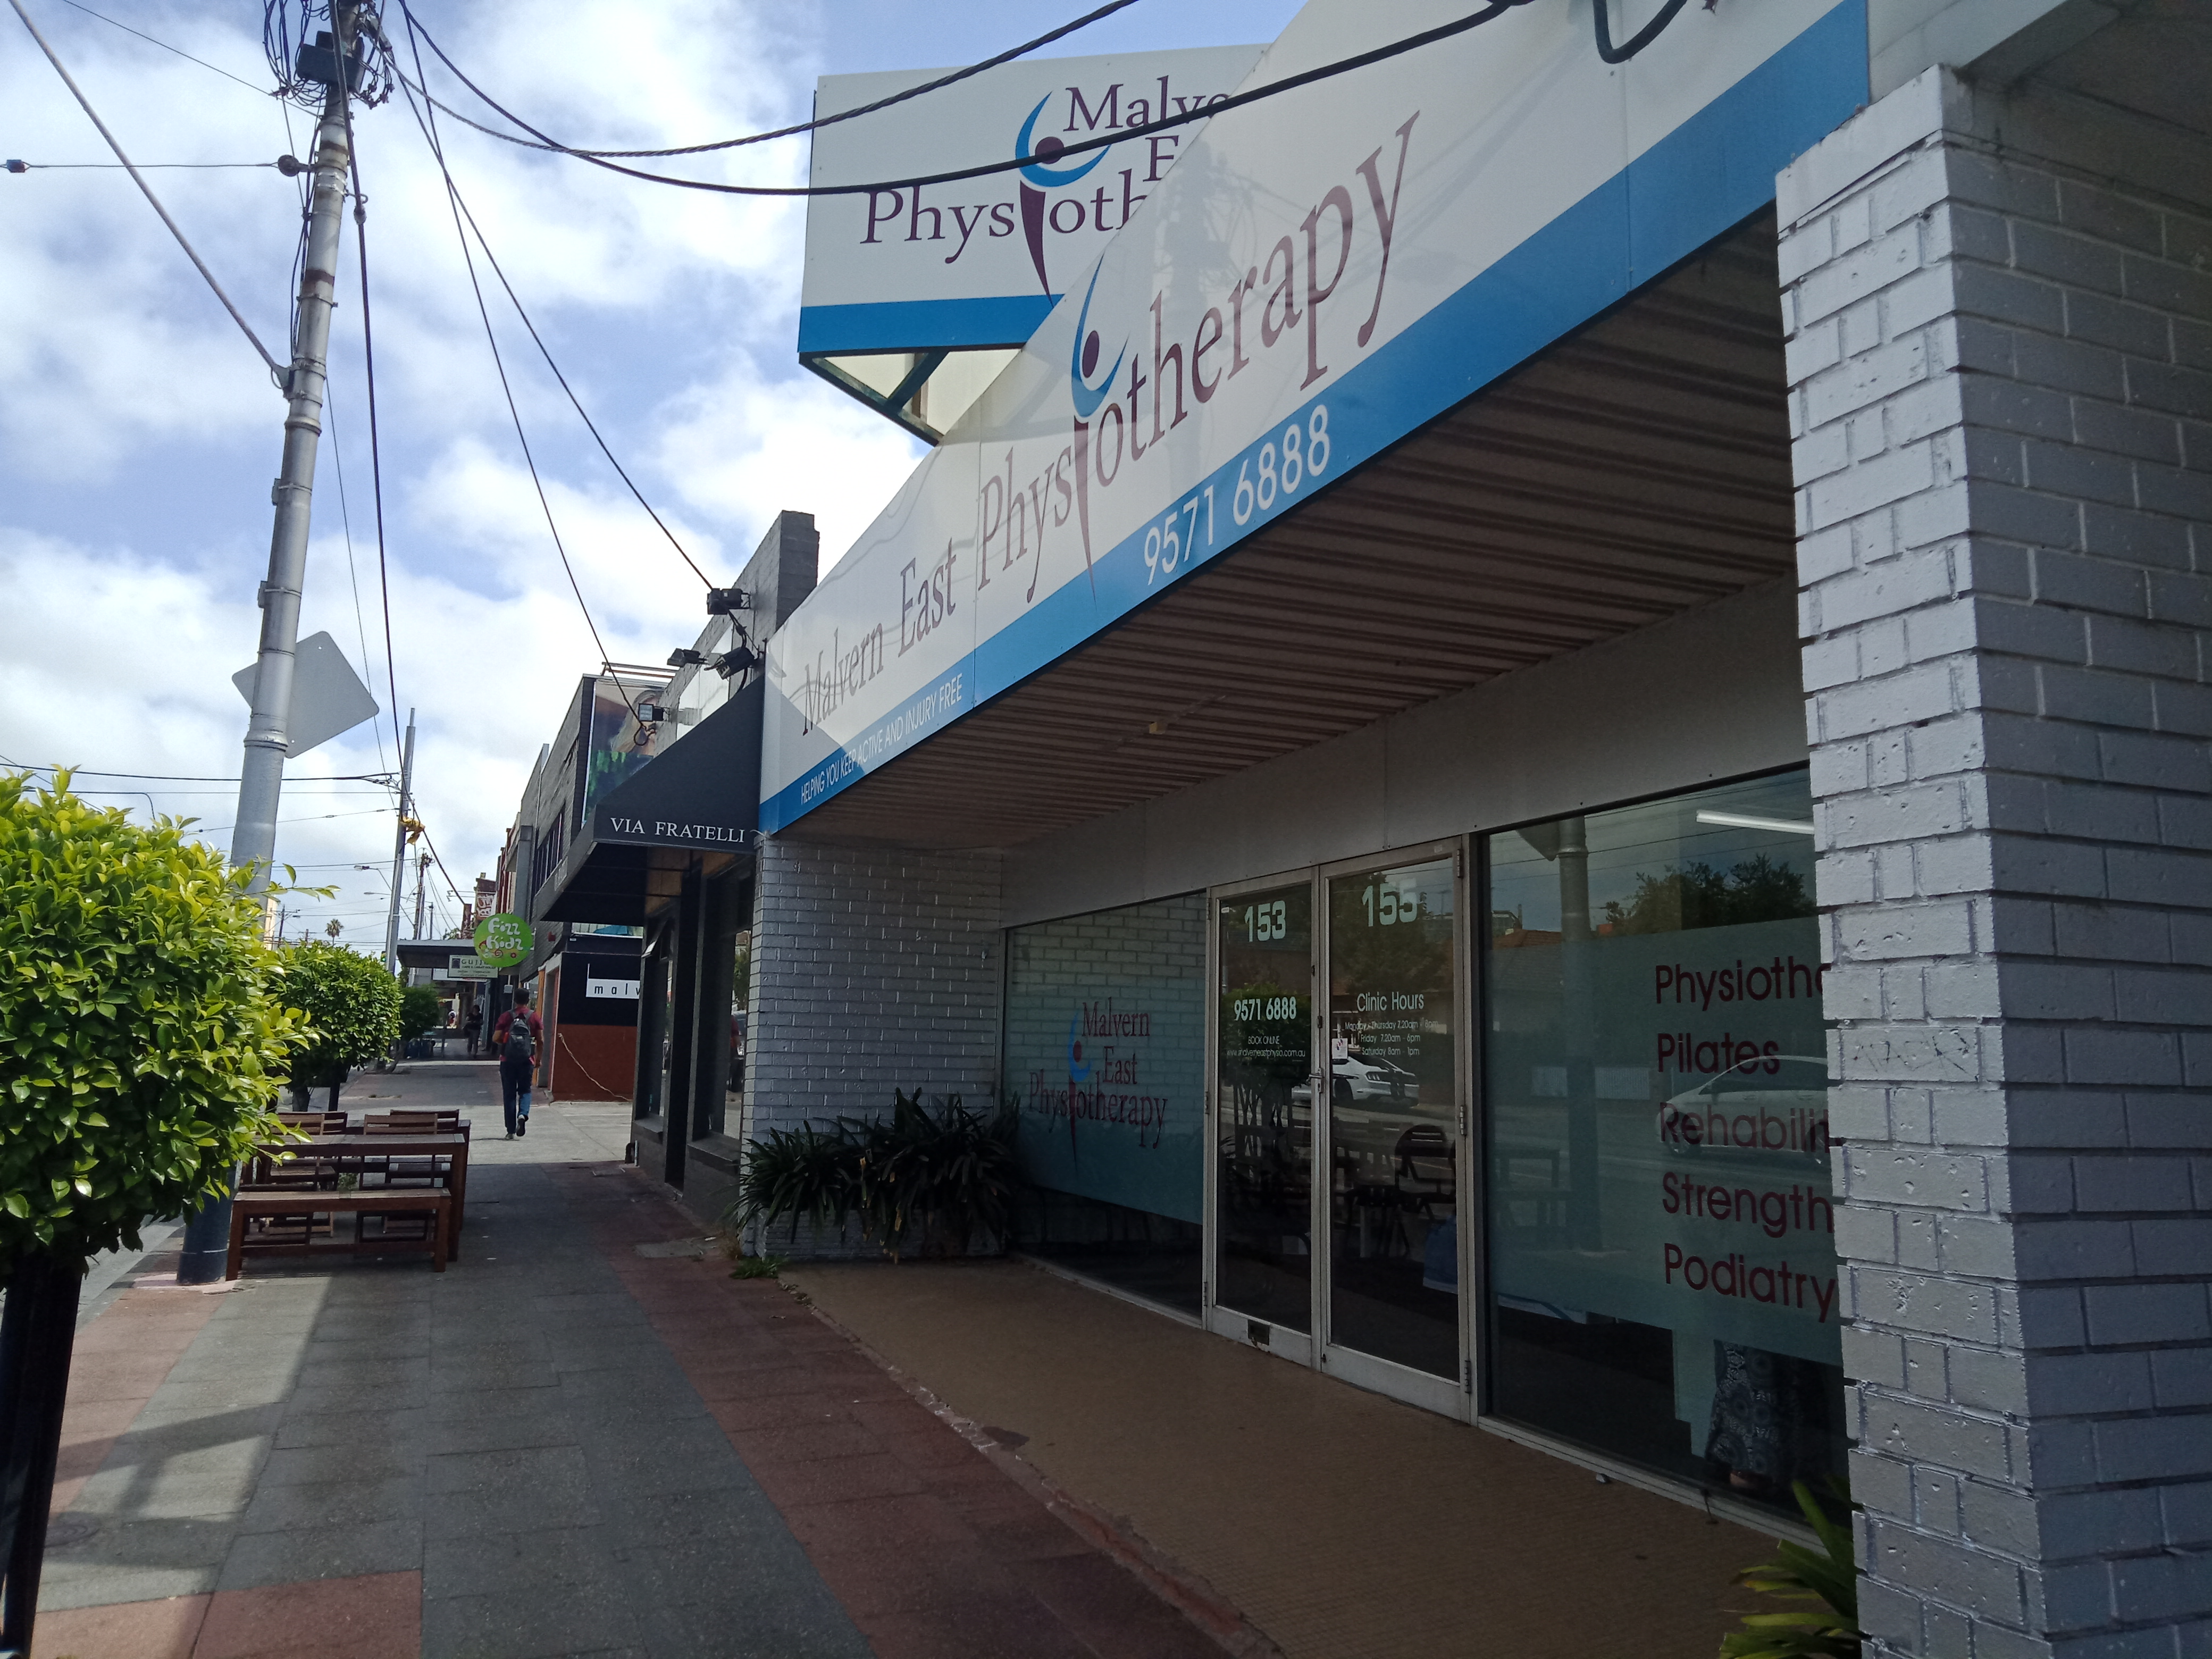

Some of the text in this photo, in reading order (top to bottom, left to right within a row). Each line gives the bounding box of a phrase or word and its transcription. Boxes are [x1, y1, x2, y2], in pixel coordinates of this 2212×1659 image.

[802, 110, 1420, 736] Malvern East Physiotherapy
[1143, 405, 1331, 586] 9571 6888
[801, 673, 963, 805] HELPING YOU KEEP ACTIVE AND INJURY FREE
[610, 817, 745, 843] VIA FRATELLI
[1244, 900, 1286, 942] 153
[1361, 879, 1418, 927] 155
[485, 935, 524, 951] Kidz
[488, 917, 521, 936] Fizz
[1081, 996, 1151, 1037] Malvern
[1234, 996, 1297, 1021] 9571 6888
[1356, 991, 1425, 1012] Clinic Hours
[1248, 1035, 1280, 1045] BOOK ONLINE
[1345, 1021, 1367, 1030] Monday
[1371, 1020, 1396, 1030] Thursday
[1397, 1020, 1418, 1029] 7.20am
[1360, 1034, 1377, 1044] Friday
[1380, 1033, 1401, 1042] 7.20am
[1406, 1033, 1421, 1043] 6pm
[1102, 1045, 1138, 1085] East
[1361, 1047, 1386, 1057] Saturday
[1387, 1047, 1401, 1055] 8am
[1407, 1046, 1420, 1056] 1pm
[1657, 1032, 1781, 1075] Pilates
[1028, 1068, 1169, 1172] Physiotherapy
[1662, 1171, 1834, 1238] Strength
[1664, 1242, 1836, 1323] Podiatry
